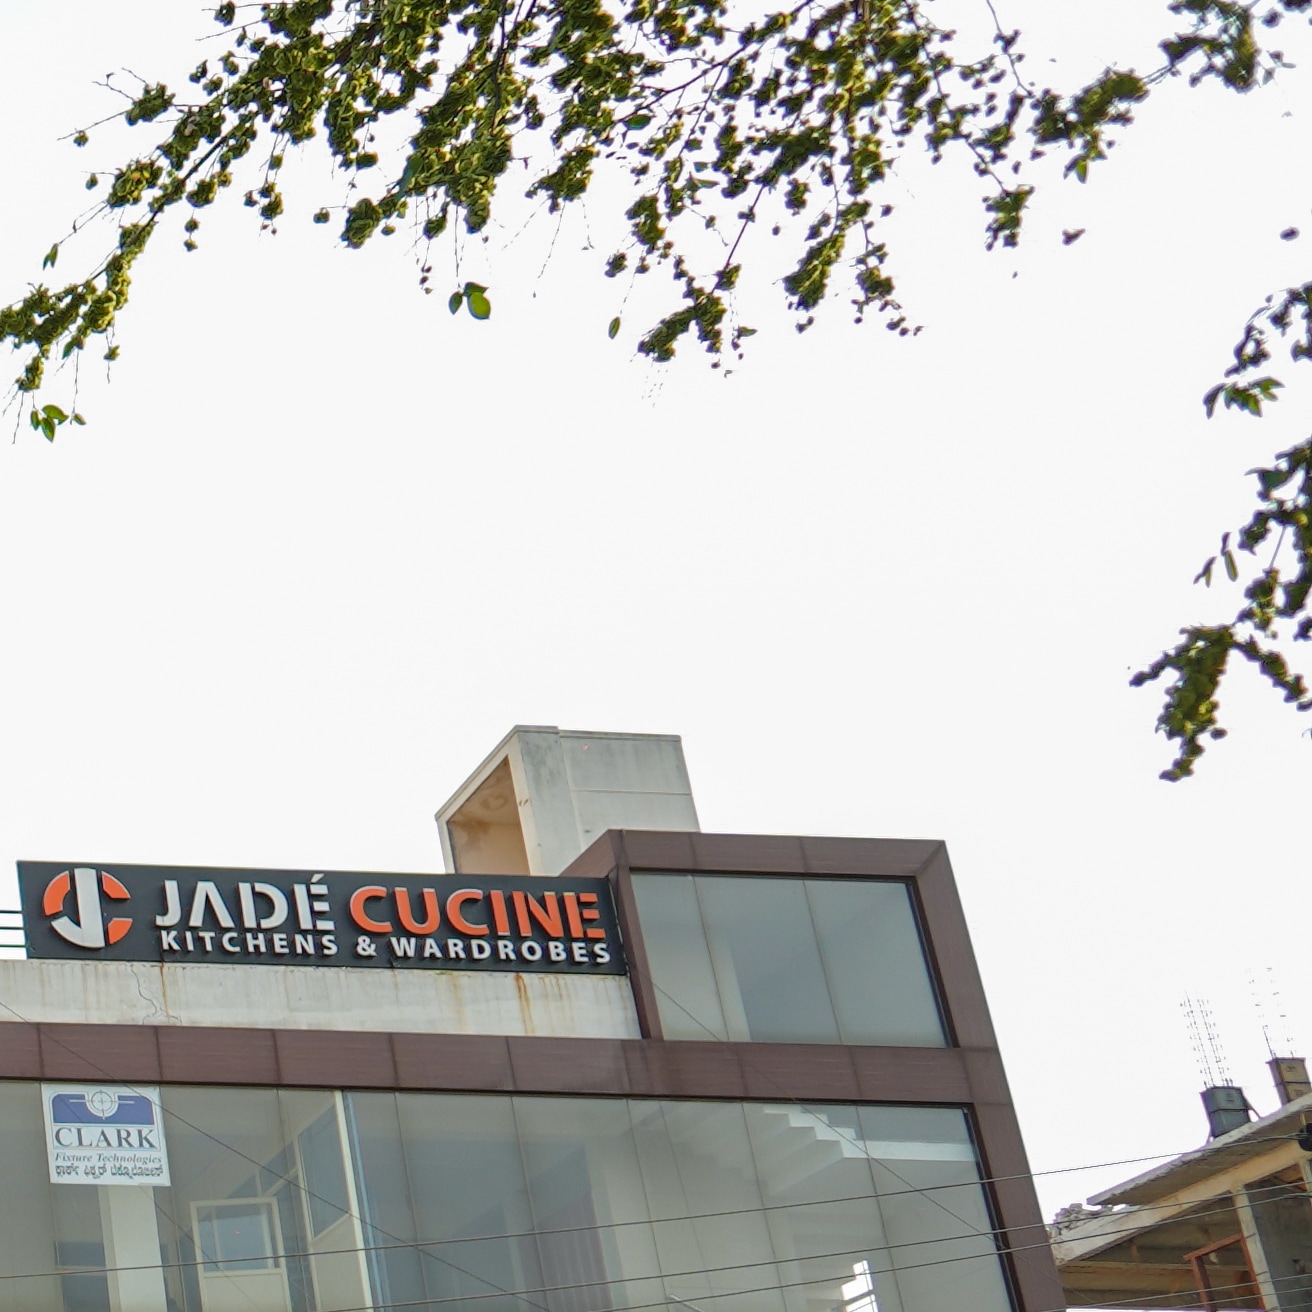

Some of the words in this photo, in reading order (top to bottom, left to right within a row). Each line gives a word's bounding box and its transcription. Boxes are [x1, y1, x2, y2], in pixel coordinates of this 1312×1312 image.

[155, 874, 335, 932] JADÉ
[350, 885, 607, 939] CUCINE
[161, 930, 339, 957] KITCHENS
[356, 936, 377, 957] &
[393, 937, 611, 965] WARDROBES
[55, 1127, 157, 1148] CLARK
[55, 1152, 92, 1162] Fixture
[96, 1153, 162, 1165] Technologies
